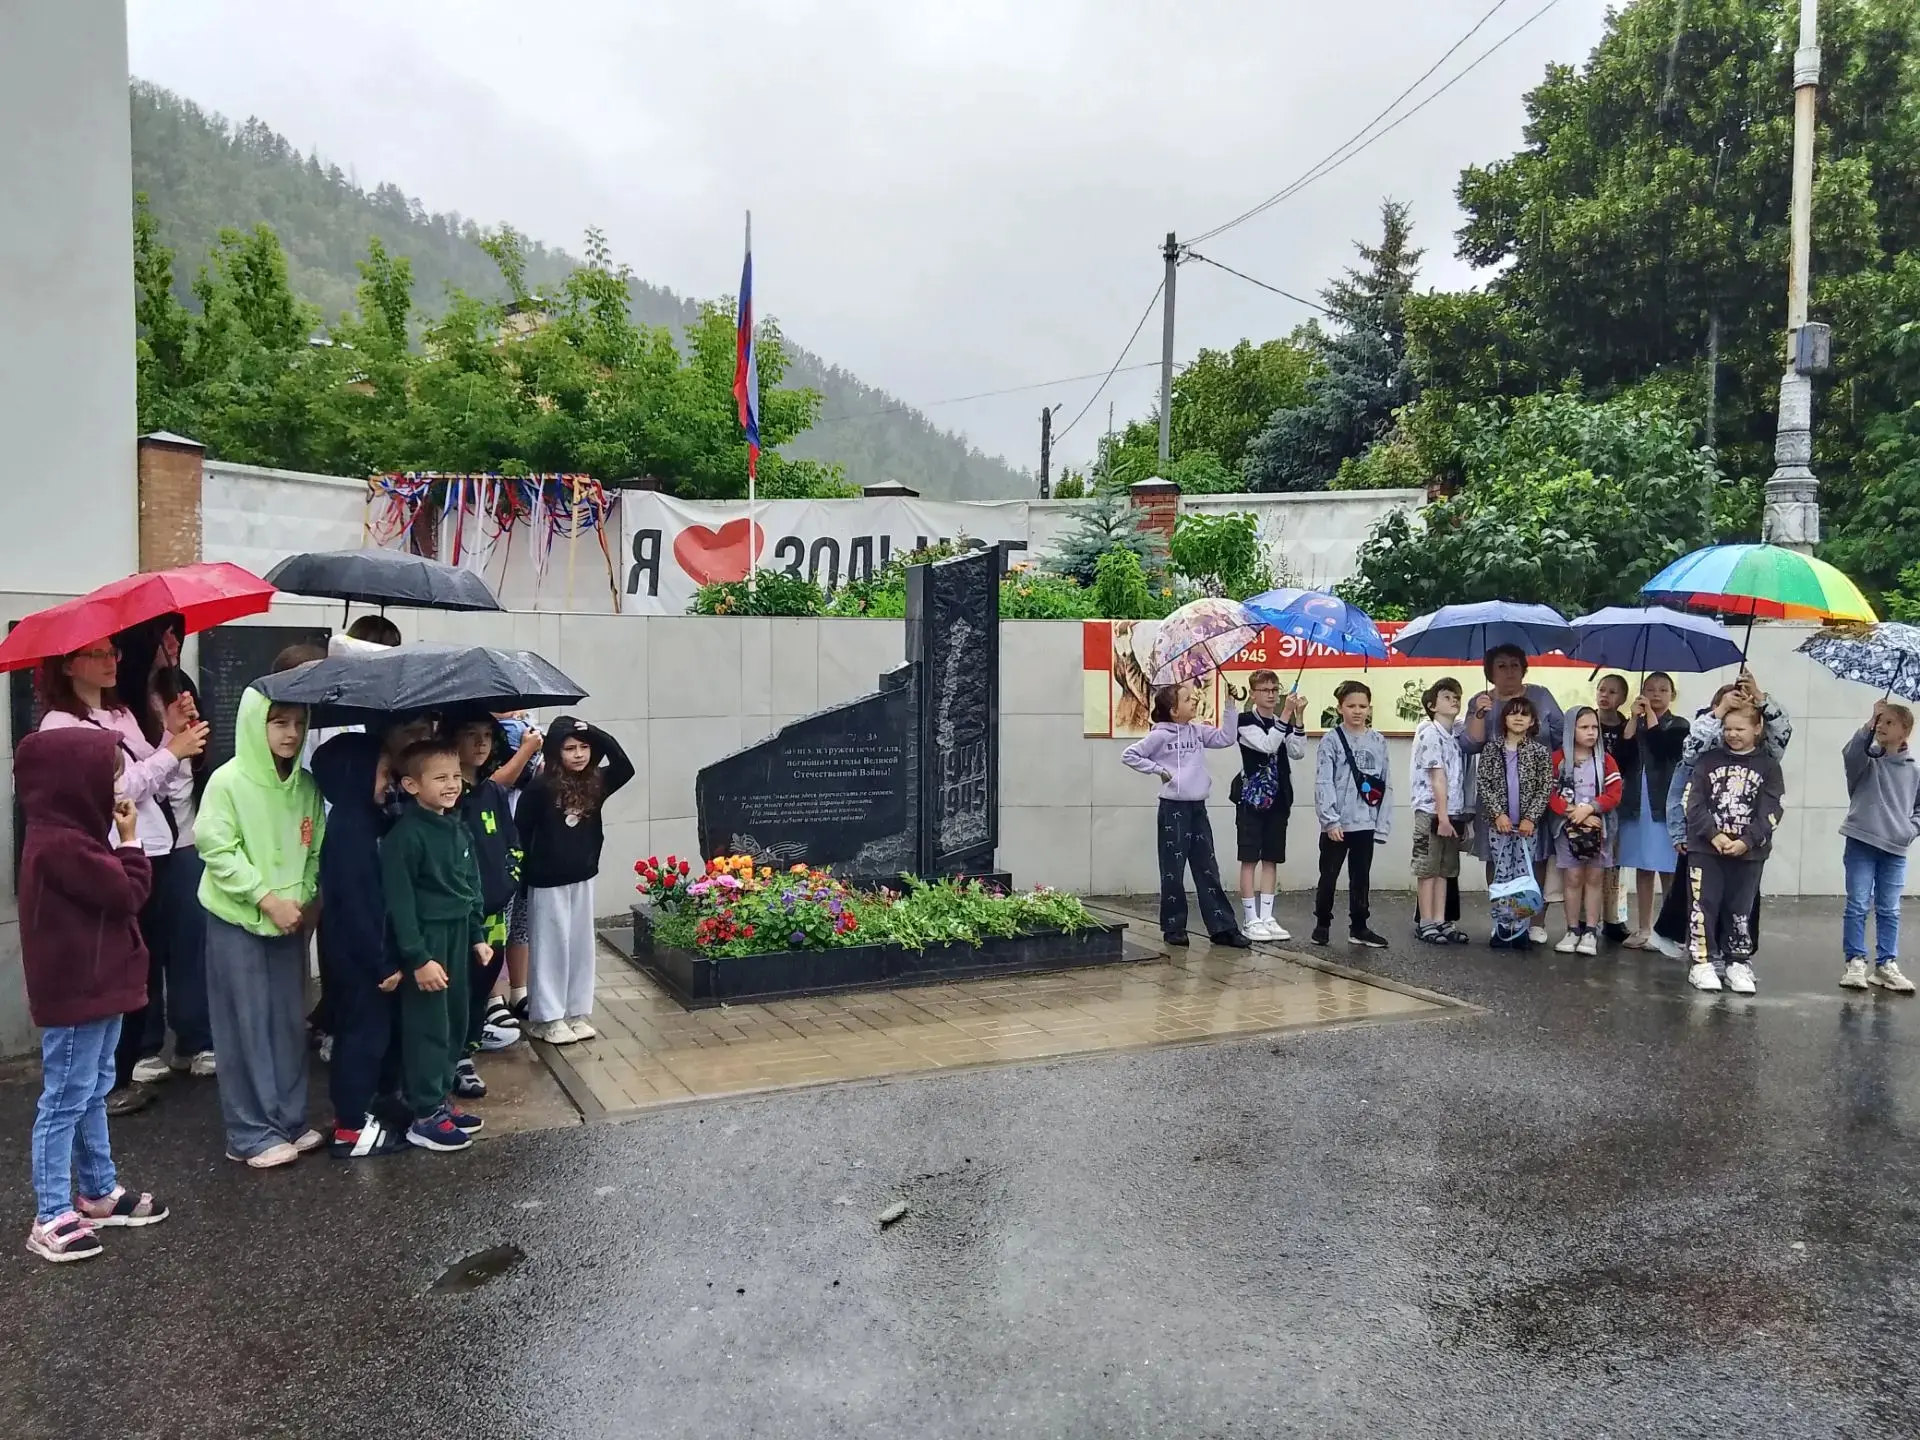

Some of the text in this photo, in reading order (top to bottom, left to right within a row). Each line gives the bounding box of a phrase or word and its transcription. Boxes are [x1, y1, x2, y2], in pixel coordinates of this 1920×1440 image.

[626, 528, 662, 596] Я
[1234, 648, 1267, 663] 1945
[1167, 734, 1204, 750] BELIEE
[863, 755, 898, 765] Великой
[936, 740, 987, 777] 1941
[793, 767, 891, 779] Отечественной Войны!
[936, 778, 987, 815] 1945
